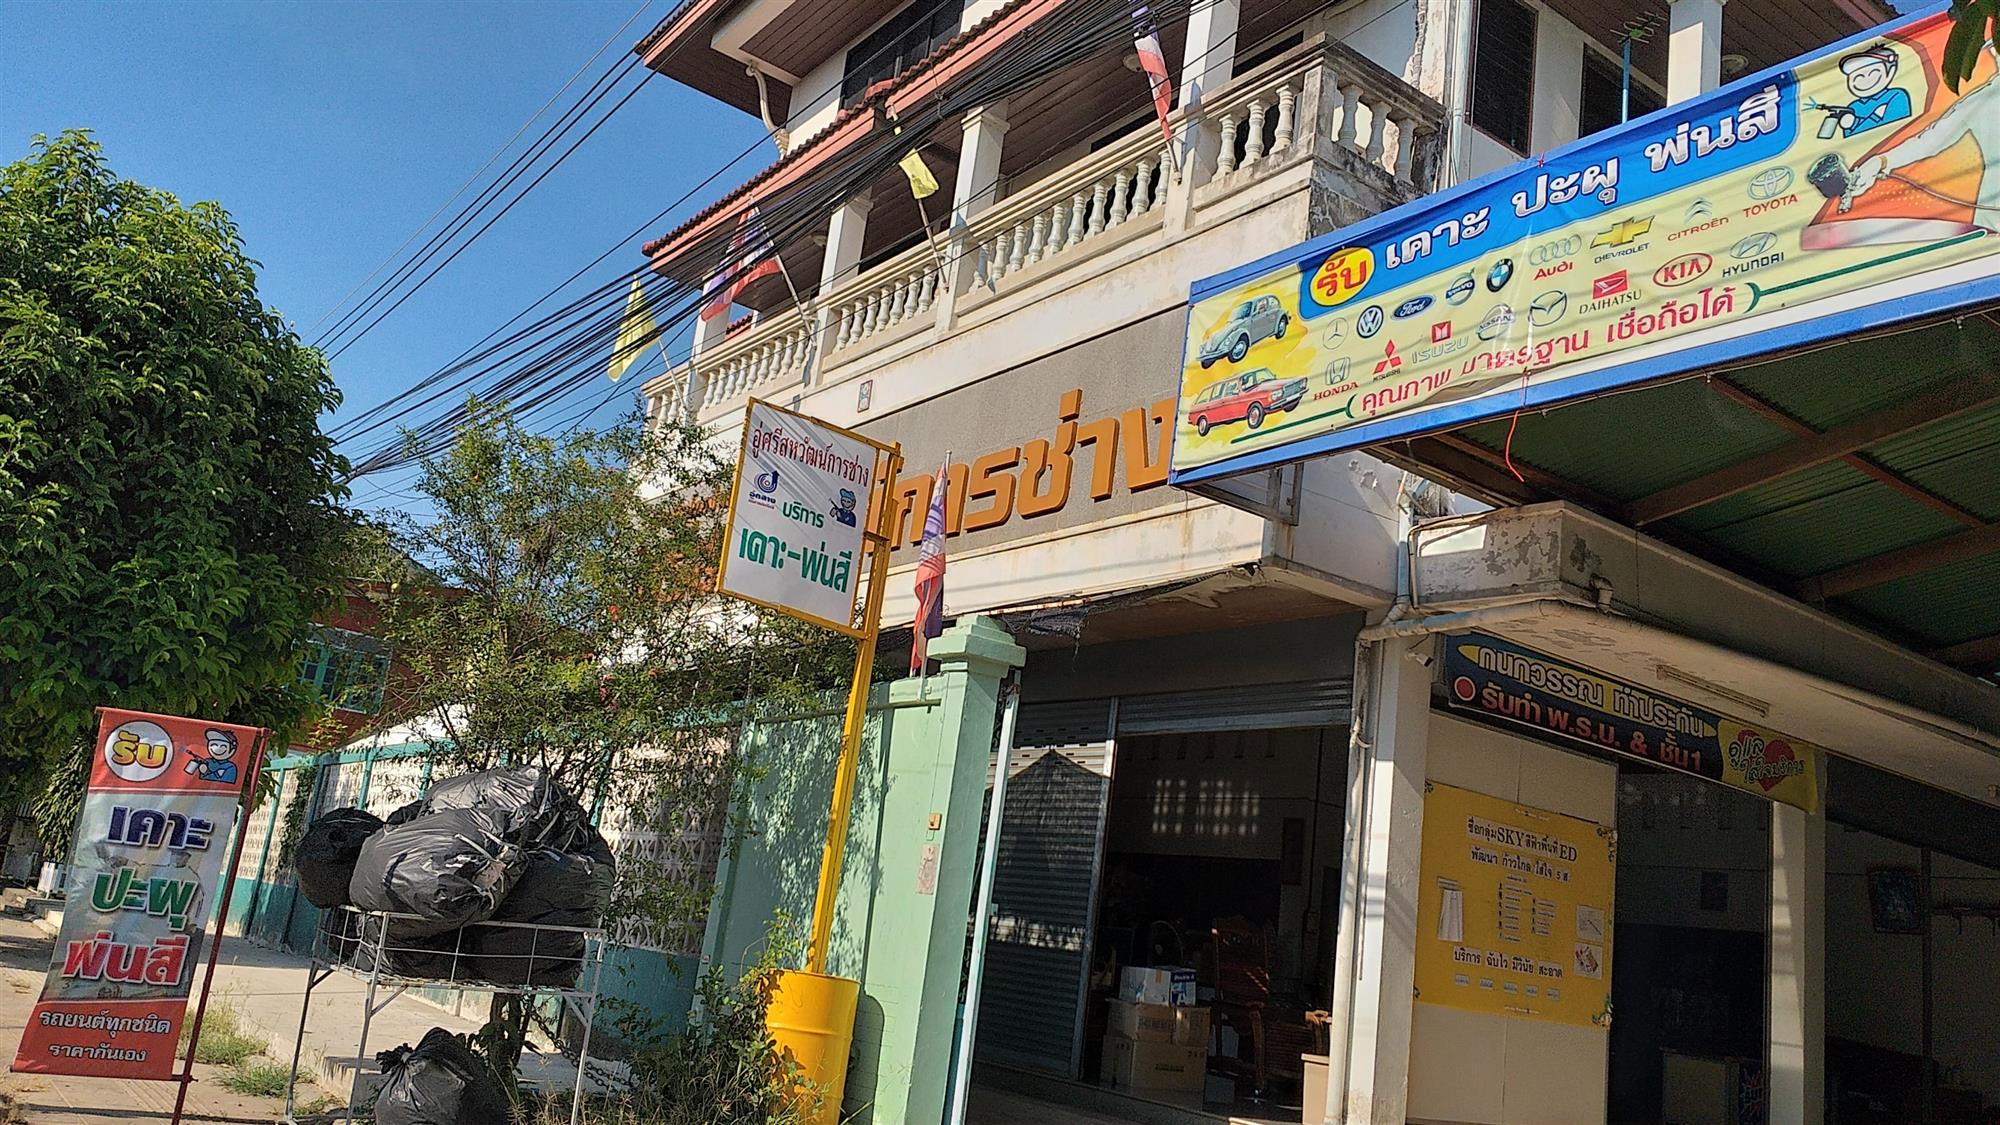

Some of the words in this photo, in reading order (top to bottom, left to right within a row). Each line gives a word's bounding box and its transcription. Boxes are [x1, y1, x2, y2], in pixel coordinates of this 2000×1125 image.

[1317, 255, 1368, 297] รับ
[1385, 205, 1491, 271] เคาะ
[1511, 157, 1620, 219] ปะผุ
[1644, 84, 1781, 173] พ่นสี
[1743, 194, 1799, 218] TOYOTA
[1594, 243, 1649, 264] CHEVROLET
[1722, 252, 1784, 278] HYUNDAI
[1664, 259, 1702, 283] KIA
[1447, 281, 1473, 296] VOLVO
[1579, 289, 1642, 315] DAIHATSU
[1400, 299, 1426, 317] Ford
[1480, 314, 1512, 330] NISSAN
[1361, 368, 1452, 416] คุณภาพ
[1607, 284, 1736, 344] เชื่อถือได้
[1412, 336, 1469, 364] ISUZU
[1314, 381, 1359, 401] HONDA
[782, 501, 825, 529] บริการ
[739, 527, 853, 593] เคาะ-พ่นสี
[1481, 681, 1542, 724] รับทำ
[1547, 706, 1621, 747] พ.ร.บ.
[1629, 730, 1649, 756] &
[1613, 685, 1704, 738] ทำประกัน
[111, 730, 168, 767] รับ
[106, 804, 215, 850] เคาะ
[1471, 846, 1498, 865] พัฒนา
[91, 867, 198, 931] ปะผุ
[61, 930, 190, 987] พ่นสี
[1454, 947, 1481, 965] บริการ
[1486, 952, 1508, 969] ฉับไว
[1538, 964, 1563, 979] สะอาด
[39, 1009, 171, 1039] รถยนต์ทุกชนิด
[48, 1043, 147, 1062] ราคากันเอง
